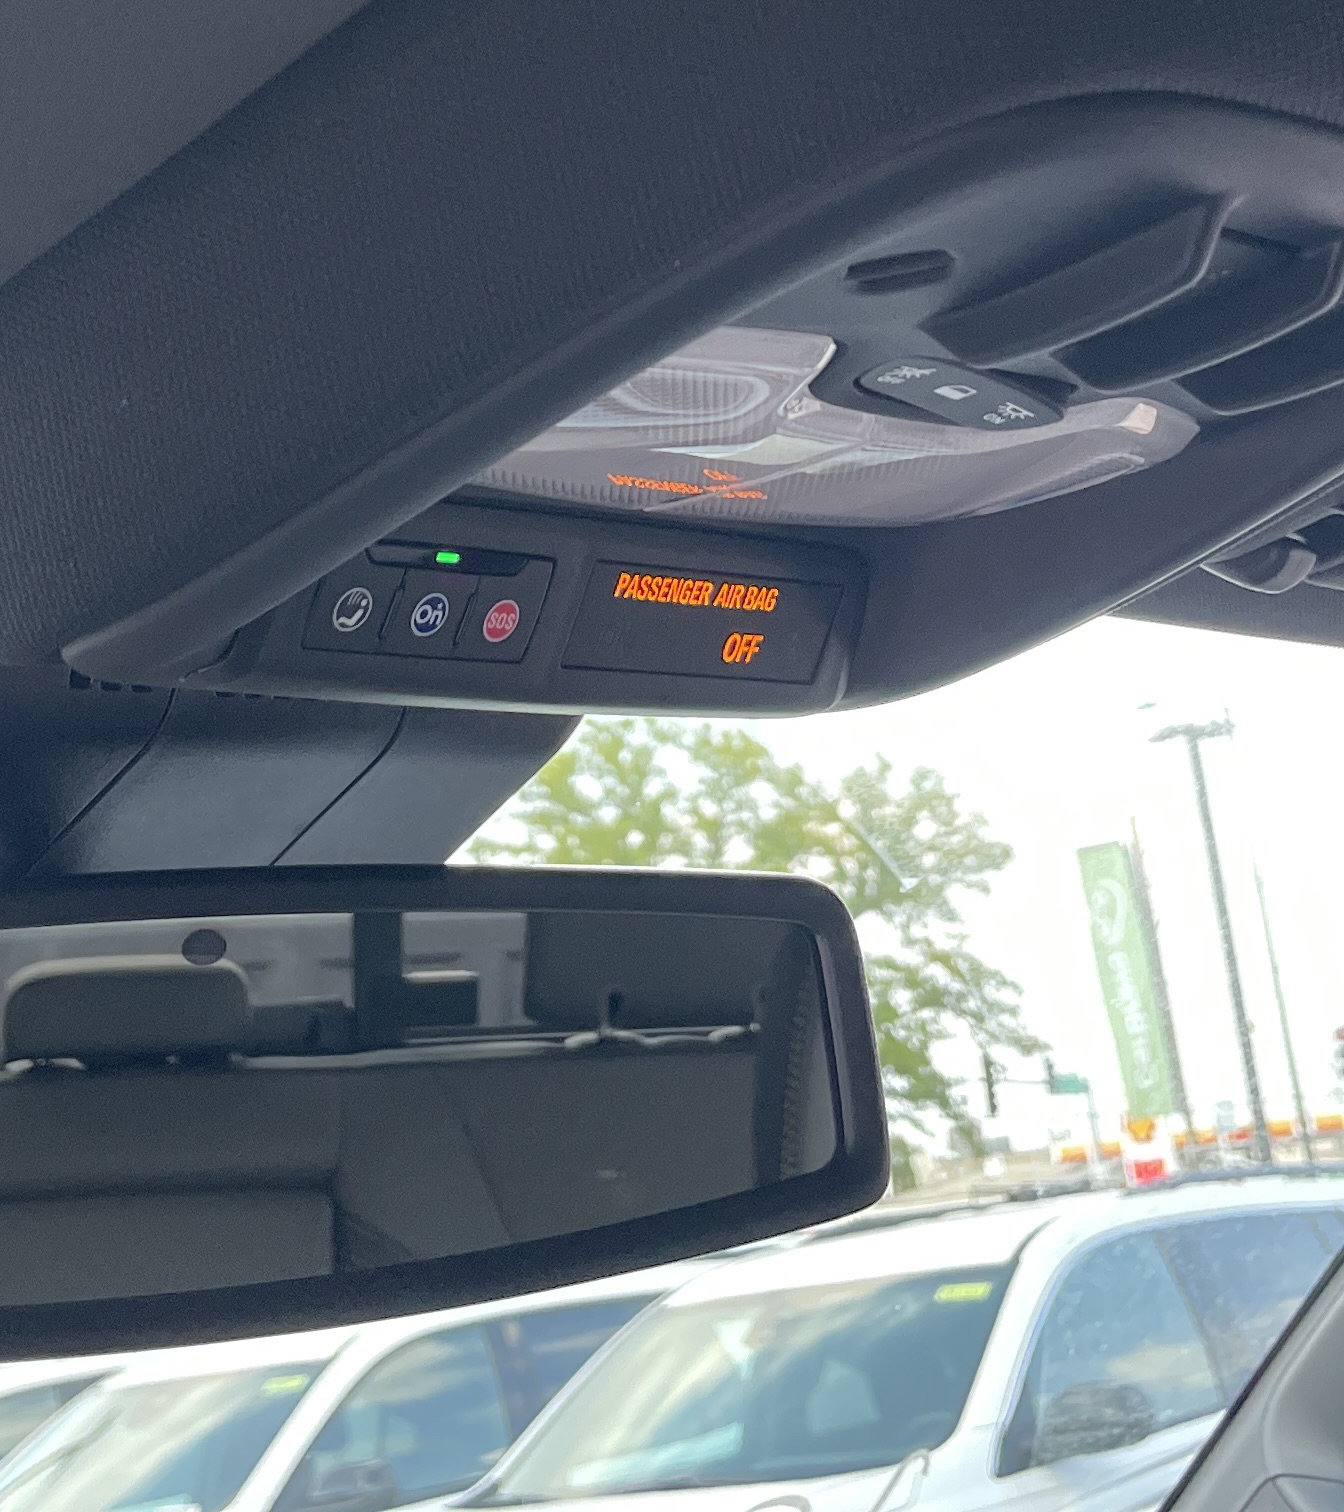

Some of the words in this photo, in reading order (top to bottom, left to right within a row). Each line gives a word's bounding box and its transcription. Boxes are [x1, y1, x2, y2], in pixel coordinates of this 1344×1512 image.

[613, 571, 714, 607] PASSENGER
[487, 612, 516, 630] SOS
[721, 631, 765, 664] OFF
